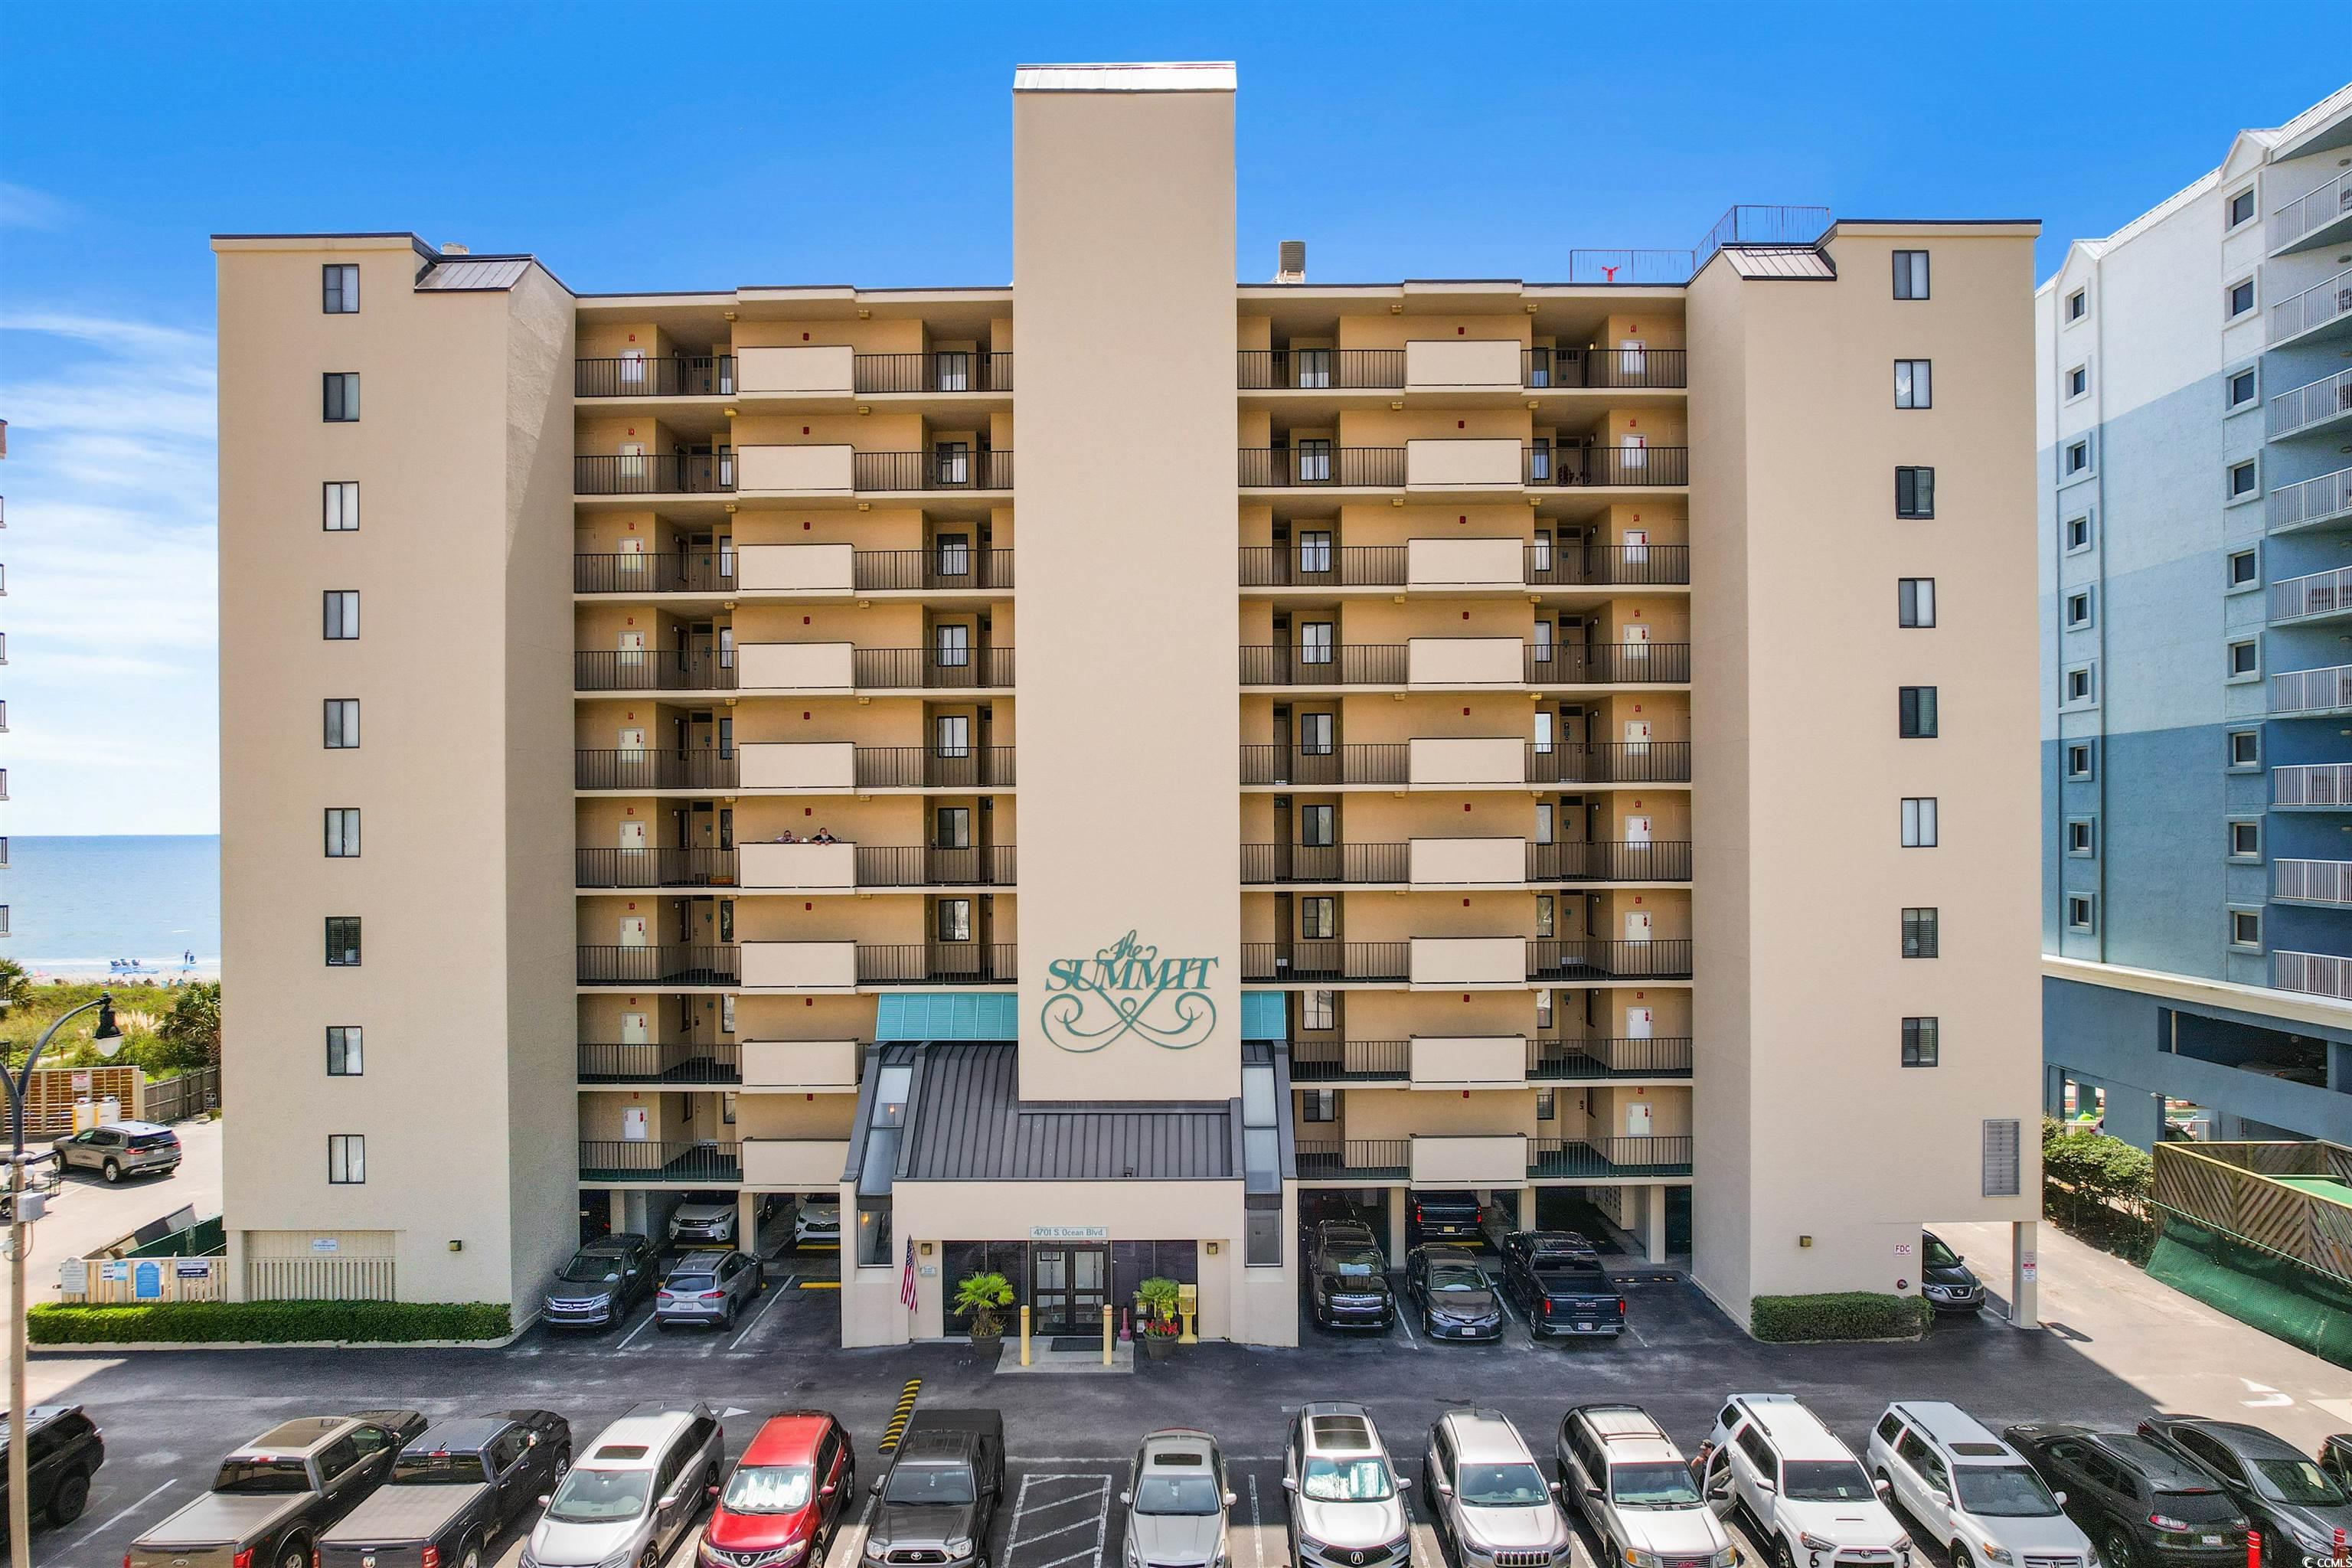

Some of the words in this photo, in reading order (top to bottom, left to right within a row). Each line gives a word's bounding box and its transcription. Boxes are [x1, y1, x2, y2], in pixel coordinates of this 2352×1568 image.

[1045, 956, 1219, 991] SUMMIT
[1034, 1228, 1052, 1236] 4701
[1062, 1228, 1084, 1236] Ocean
